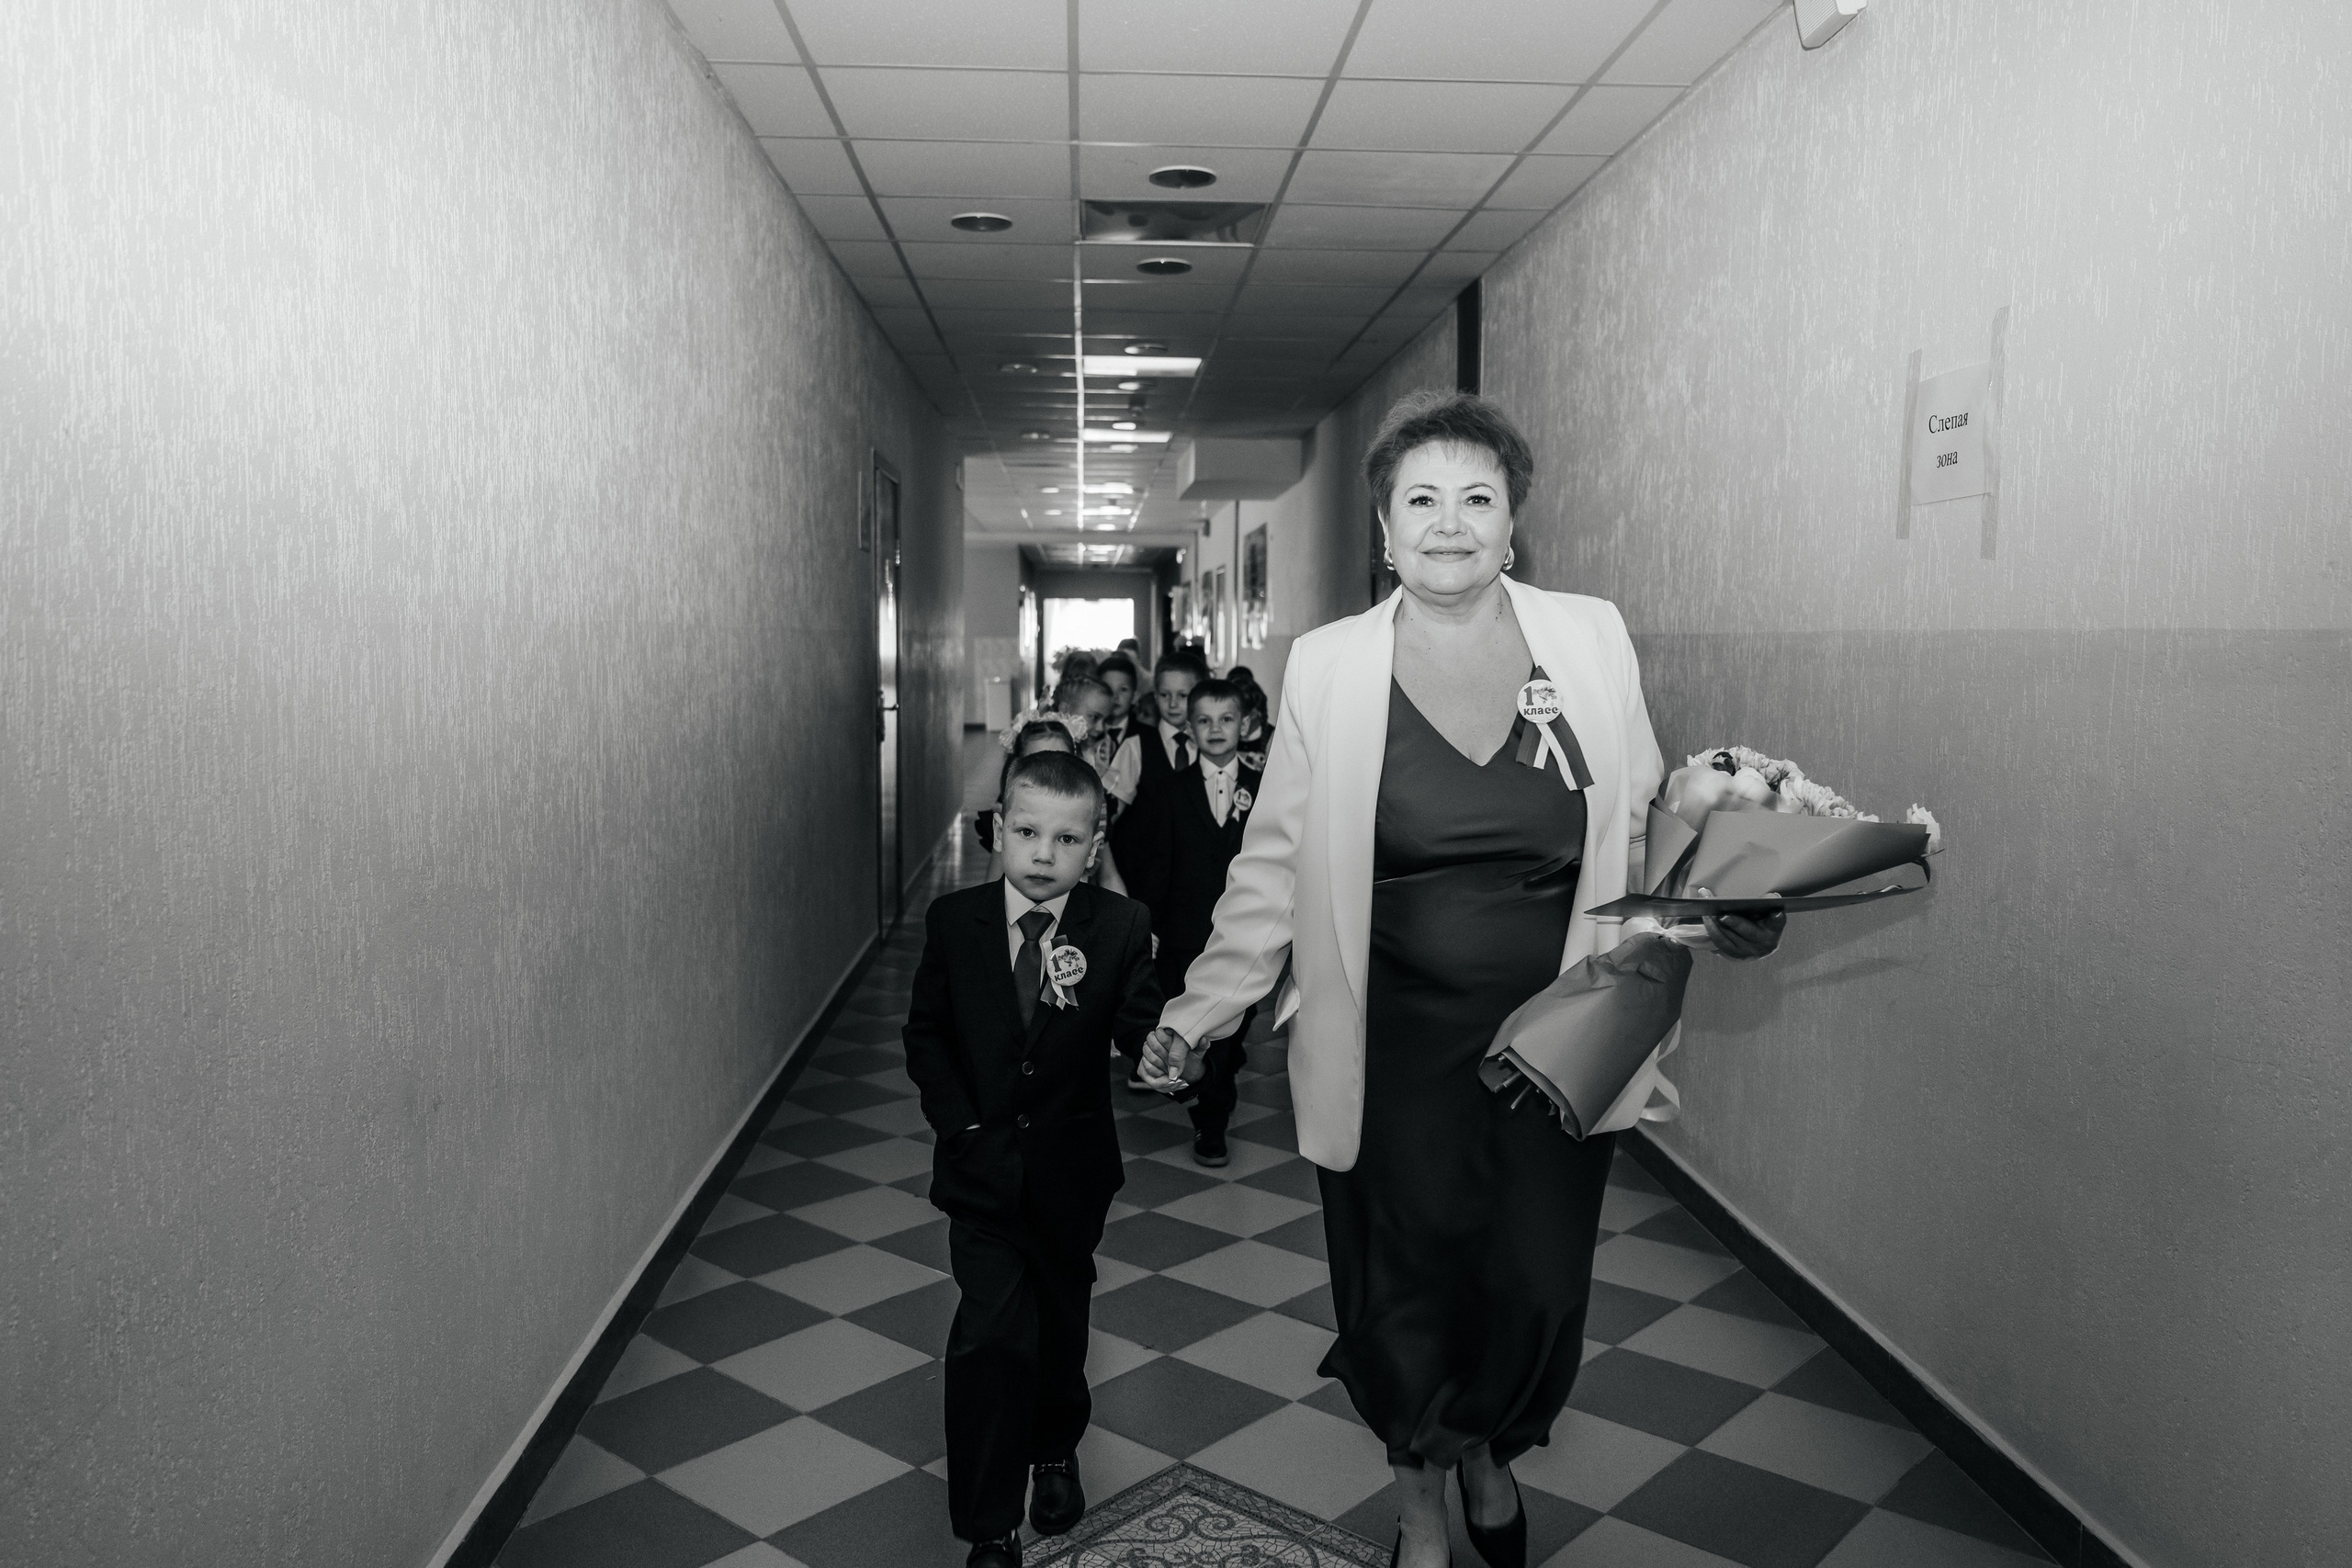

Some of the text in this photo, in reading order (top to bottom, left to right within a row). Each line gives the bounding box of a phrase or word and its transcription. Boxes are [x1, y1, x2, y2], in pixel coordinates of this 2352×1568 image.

[1928, 412, 1969, 434] Слепая
[1936, 451, 1958, 468] зона
[1523, 685, 1534, 706] 1
[1523, 706, 1559, 716] класс
[1050, 953, 1062, 973] 1
[1054, 966, 1084, 982] класс
